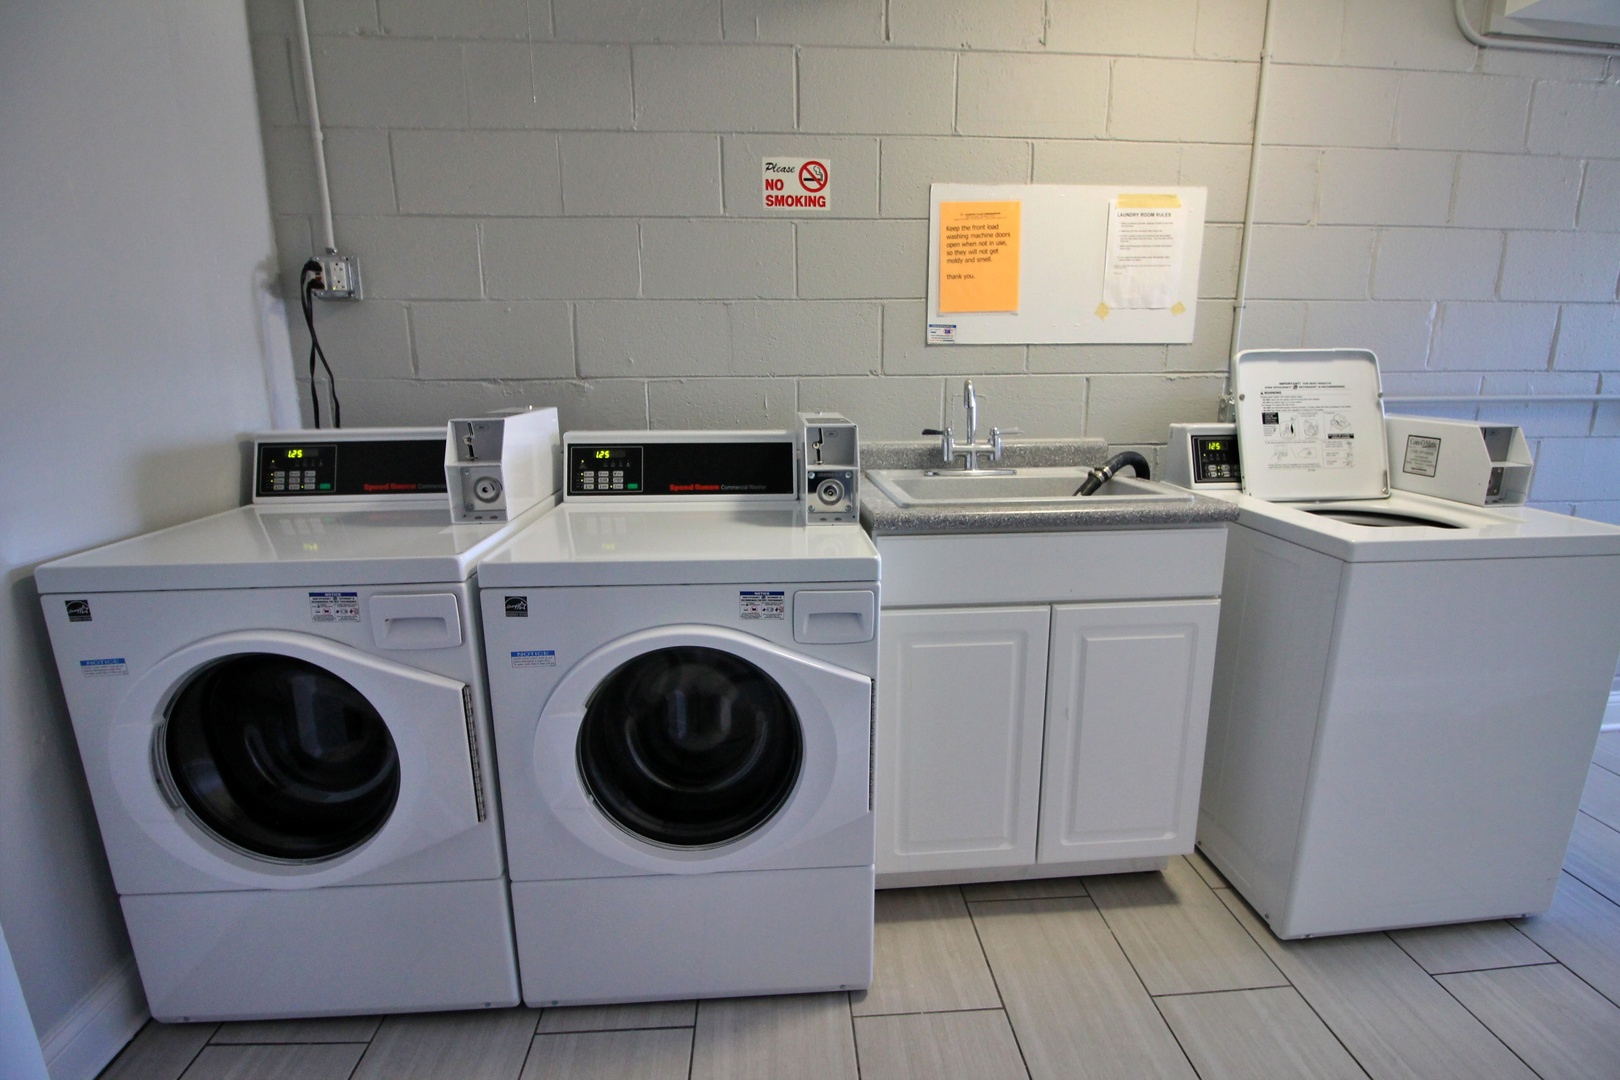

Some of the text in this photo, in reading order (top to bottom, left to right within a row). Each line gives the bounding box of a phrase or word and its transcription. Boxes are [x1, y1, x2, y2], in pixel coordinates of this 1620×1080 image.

[765, 162, 795, 173] Please
[765, 179, 784, 191] NO
[765, 194, 826, 207] SMOKING
[946, 224, 960, 232] Keep
[363, 483, 389, 491] Speed
[669, 484, 694, 492] Speed
